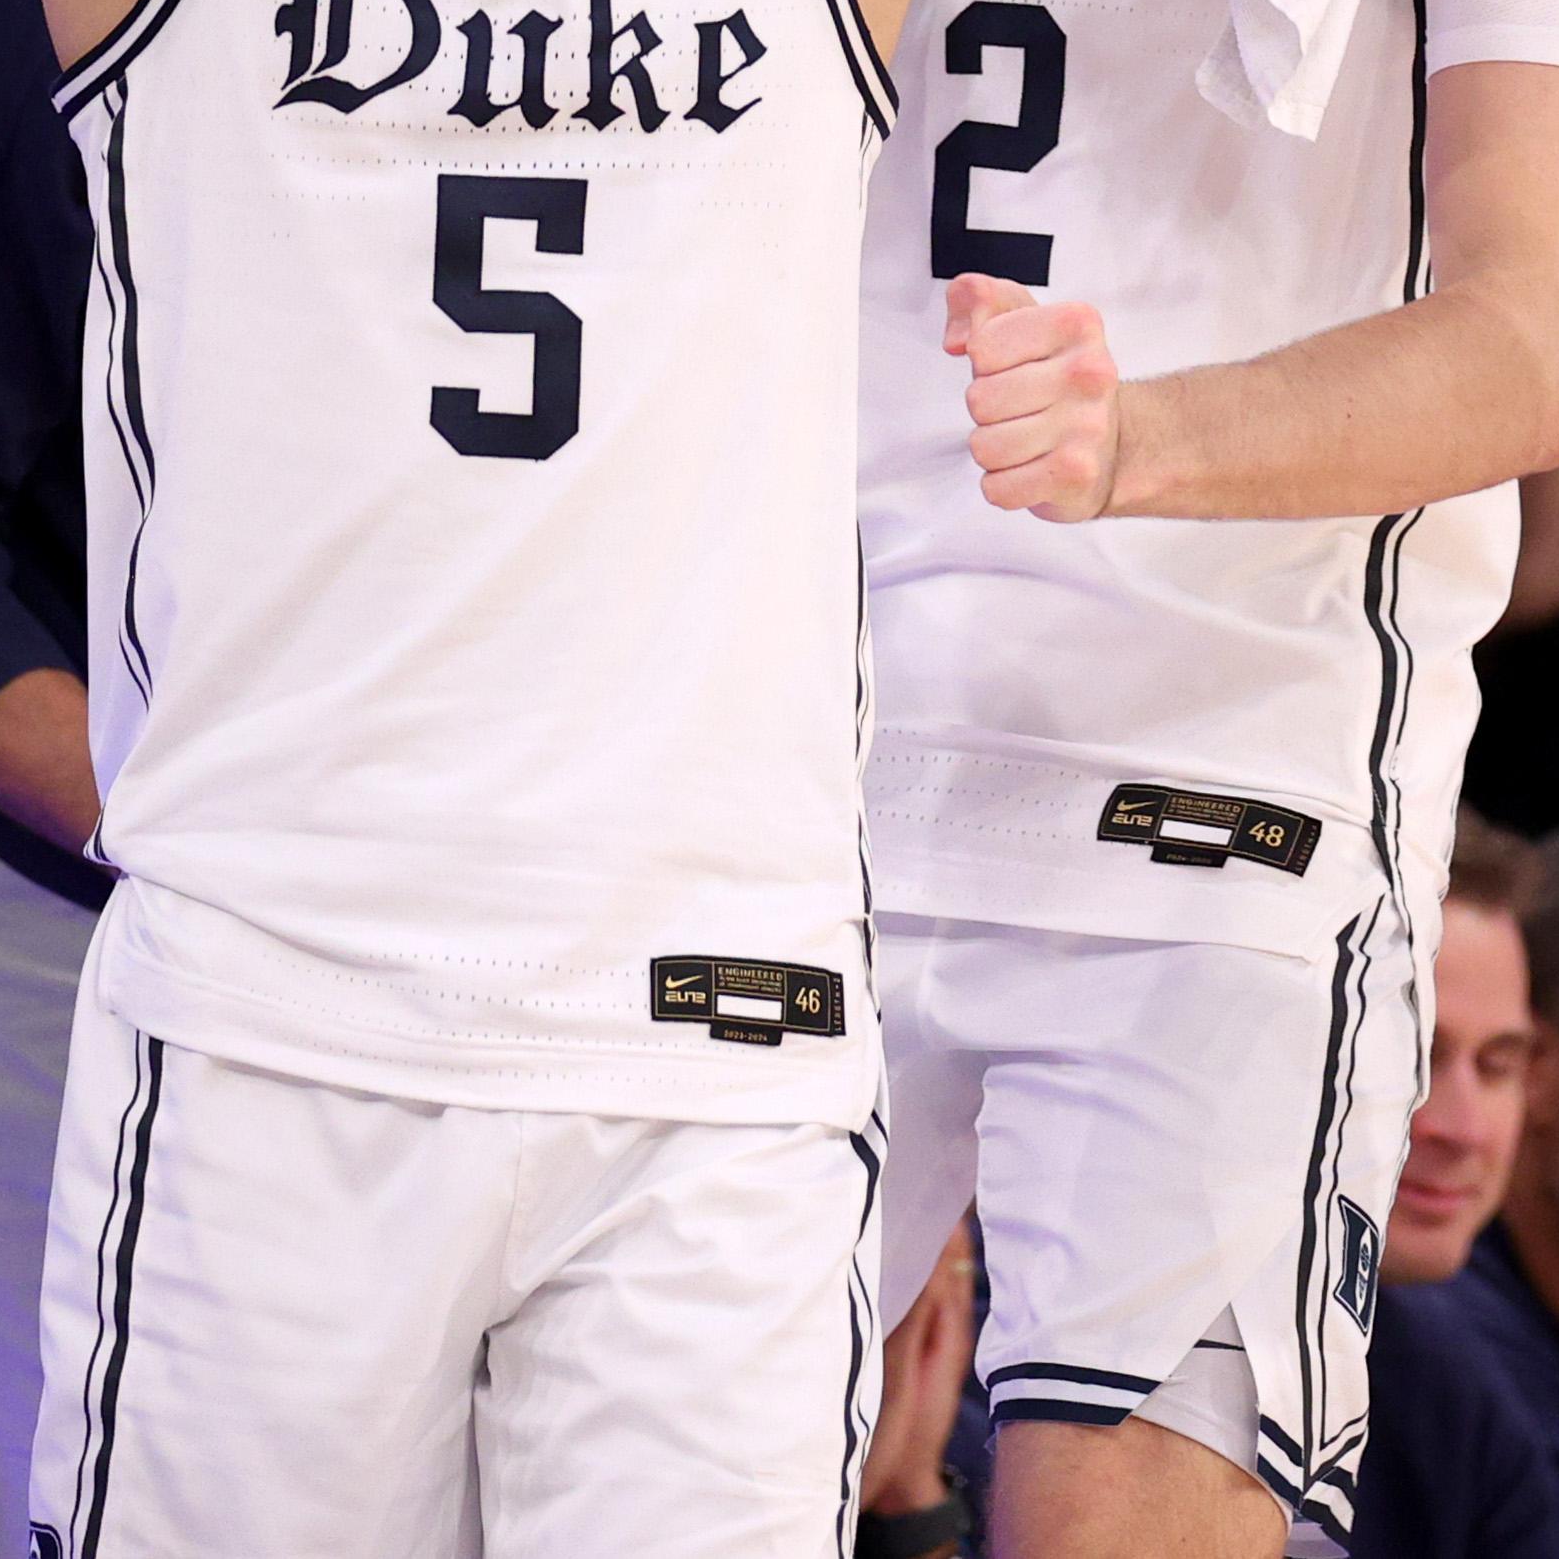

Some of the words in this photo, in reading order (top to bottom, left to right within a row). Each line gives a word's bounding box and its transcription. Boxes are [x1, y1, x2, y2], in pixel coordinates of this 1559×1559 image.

[931, 1, 1067, 287] 2
[430, 173, 589, 462] 5
[1248, 821, 1285, 847] 48
[795, 987, 821, 1014] 46
